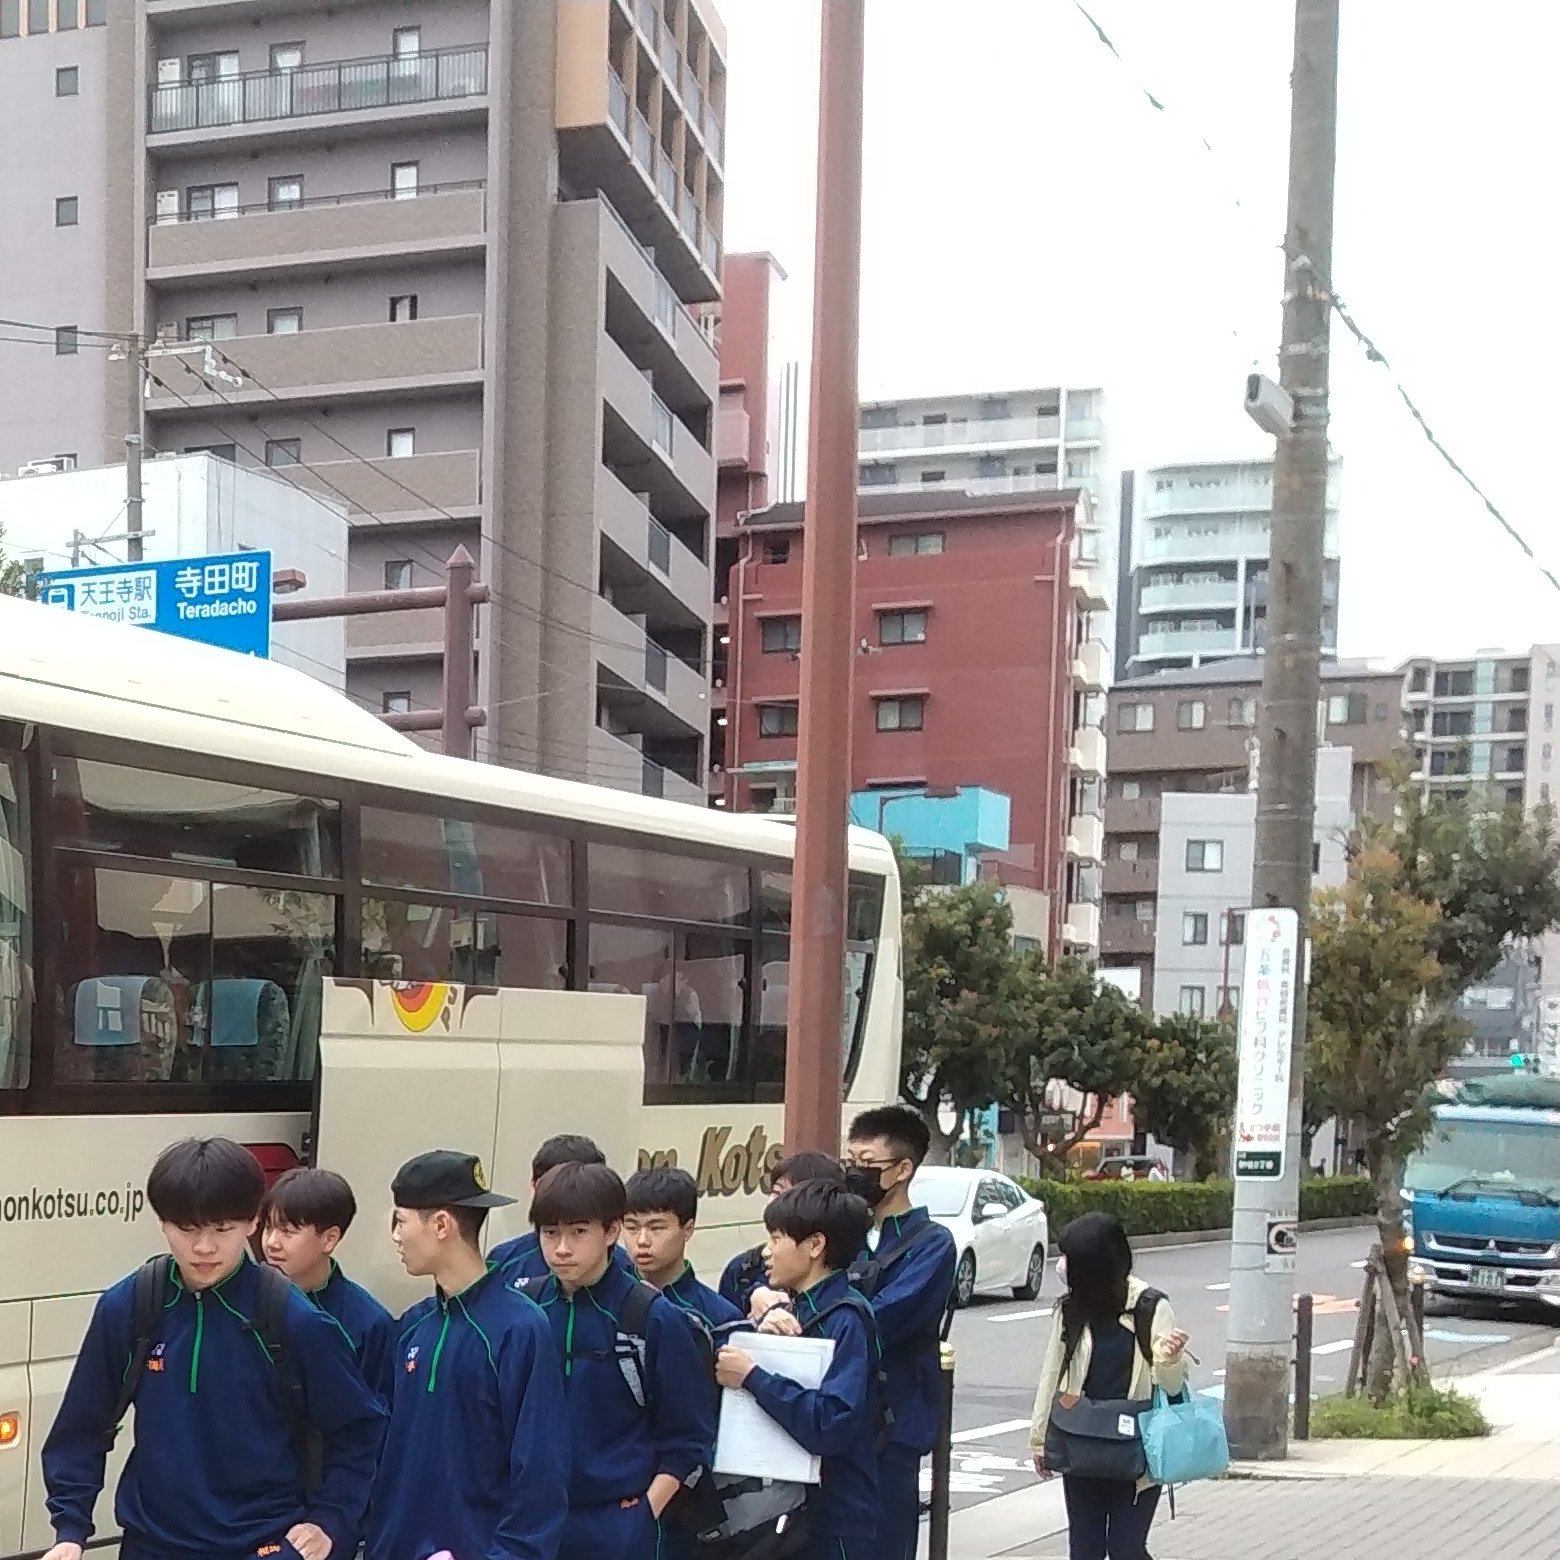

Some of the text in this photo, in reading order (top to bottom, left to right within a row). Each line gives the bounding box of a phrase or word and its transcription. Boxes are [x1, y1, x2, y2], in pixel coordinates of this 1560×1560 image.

[80, 576, 152, 606] 天王寺駅
[175, 561, 260, 598] 寺田町
[81, 606, 151, 622] nnoji Sta.
[176, 597, 257, 619] Teradacho
